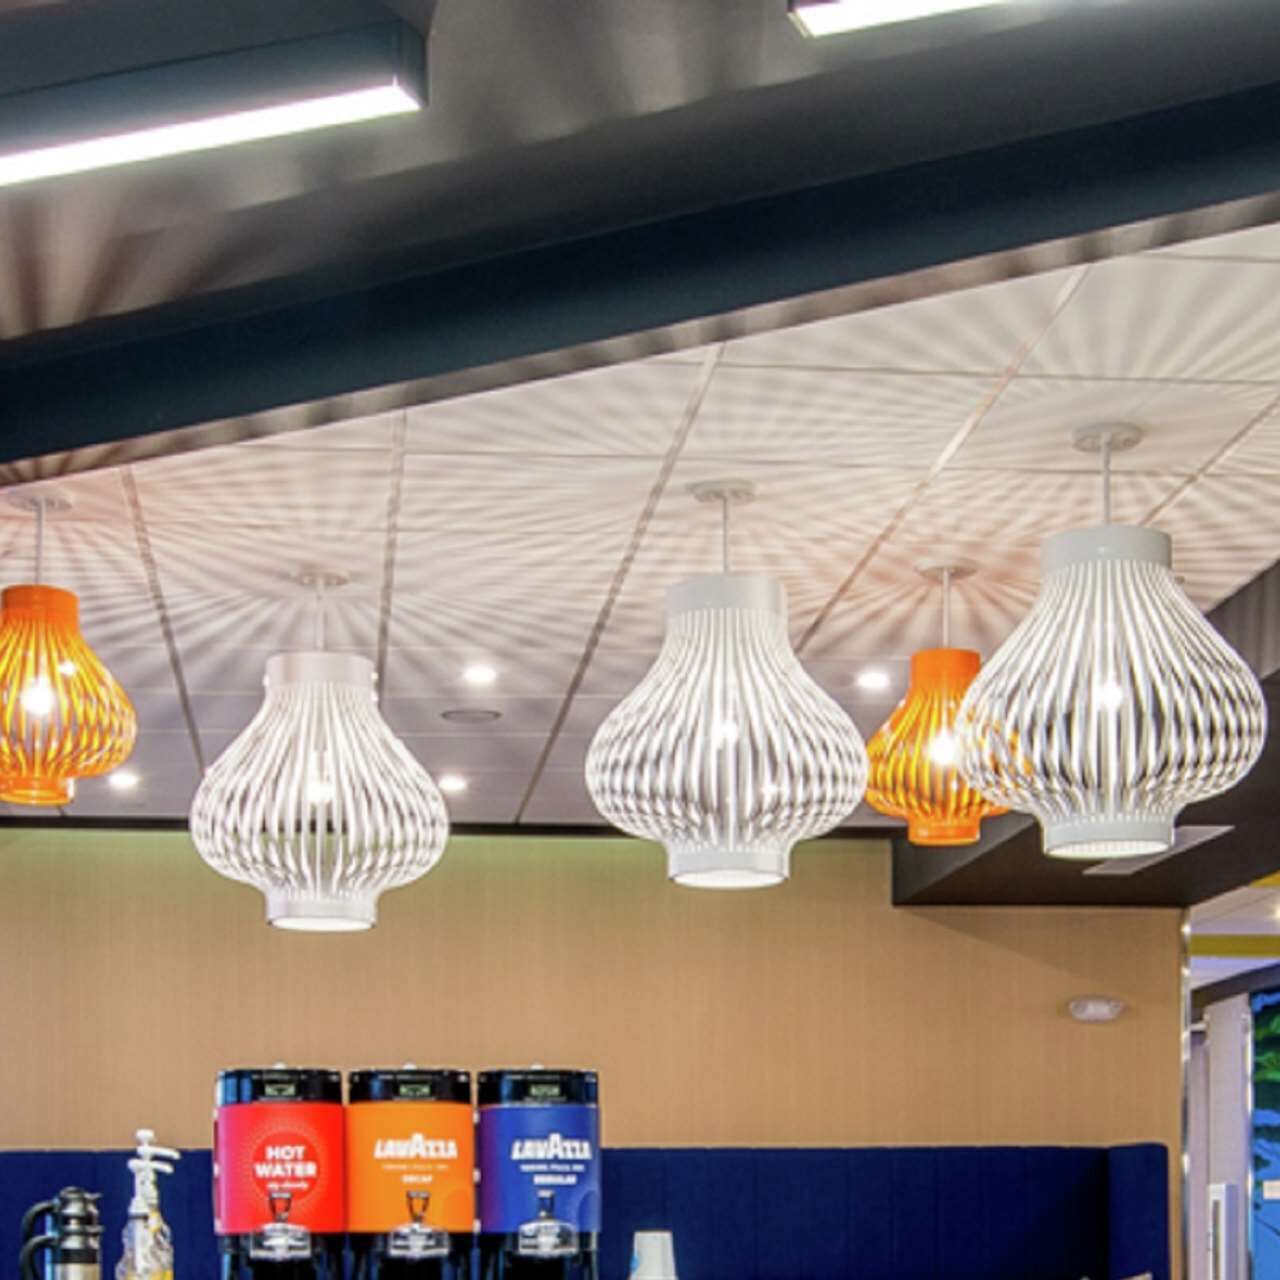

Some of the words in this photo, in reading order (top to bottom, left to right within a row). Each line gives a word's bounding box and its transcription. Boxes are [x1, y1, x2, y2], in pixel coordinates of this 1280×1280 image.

[265, 1145, 306, 1160] HOT
[373, 1132, 458, 1160] LAVAZZA
[511, 1132, 593, 1160] LAVAZZA
[254, 1162, 317, 1178] WATER
